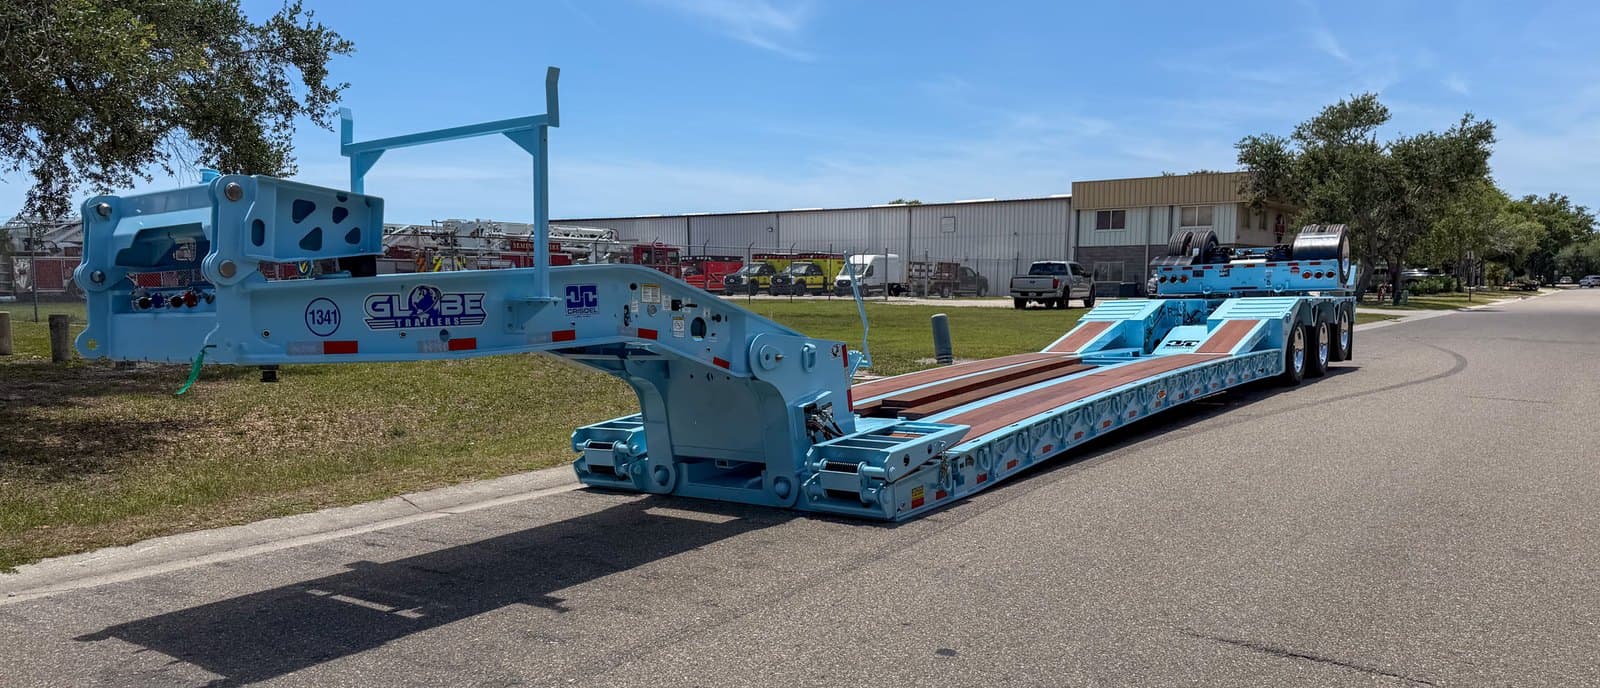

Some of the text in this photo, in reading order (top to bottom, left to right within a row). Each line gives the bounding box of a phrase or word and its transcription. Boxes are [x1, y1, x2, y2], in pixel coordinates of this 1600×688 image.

[364, 285, 486, 319] GLOBE
[309, 309, 337, 325] 1341
[395, 317, 460, 328] TRAILERS
